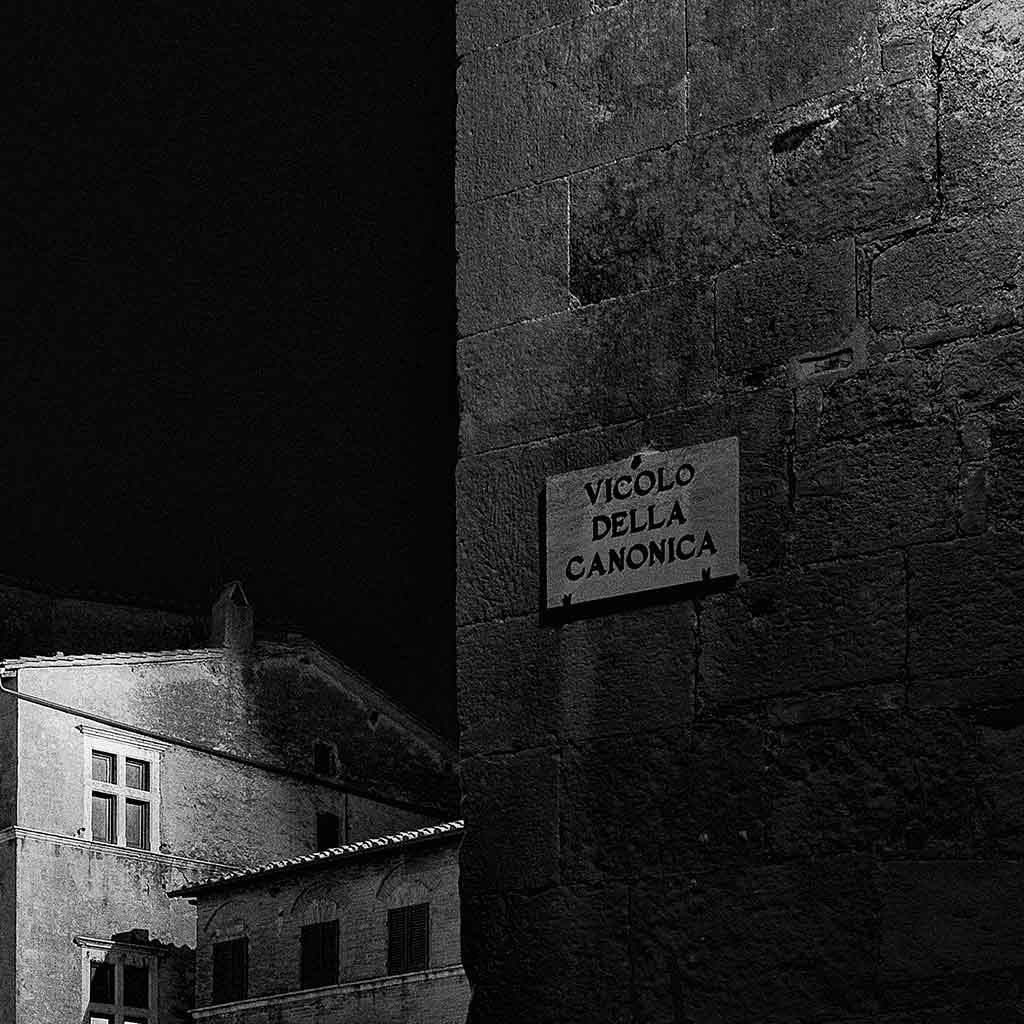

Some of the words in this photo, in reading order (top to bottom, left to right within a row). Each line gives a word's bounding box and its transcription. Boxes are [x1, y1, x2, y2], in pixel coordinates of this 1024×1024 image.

[584, 464, 695, 505] VICOLO
[592, 500, 687, 541] DELLA
[566, 530, 717, 581] CANONICA
